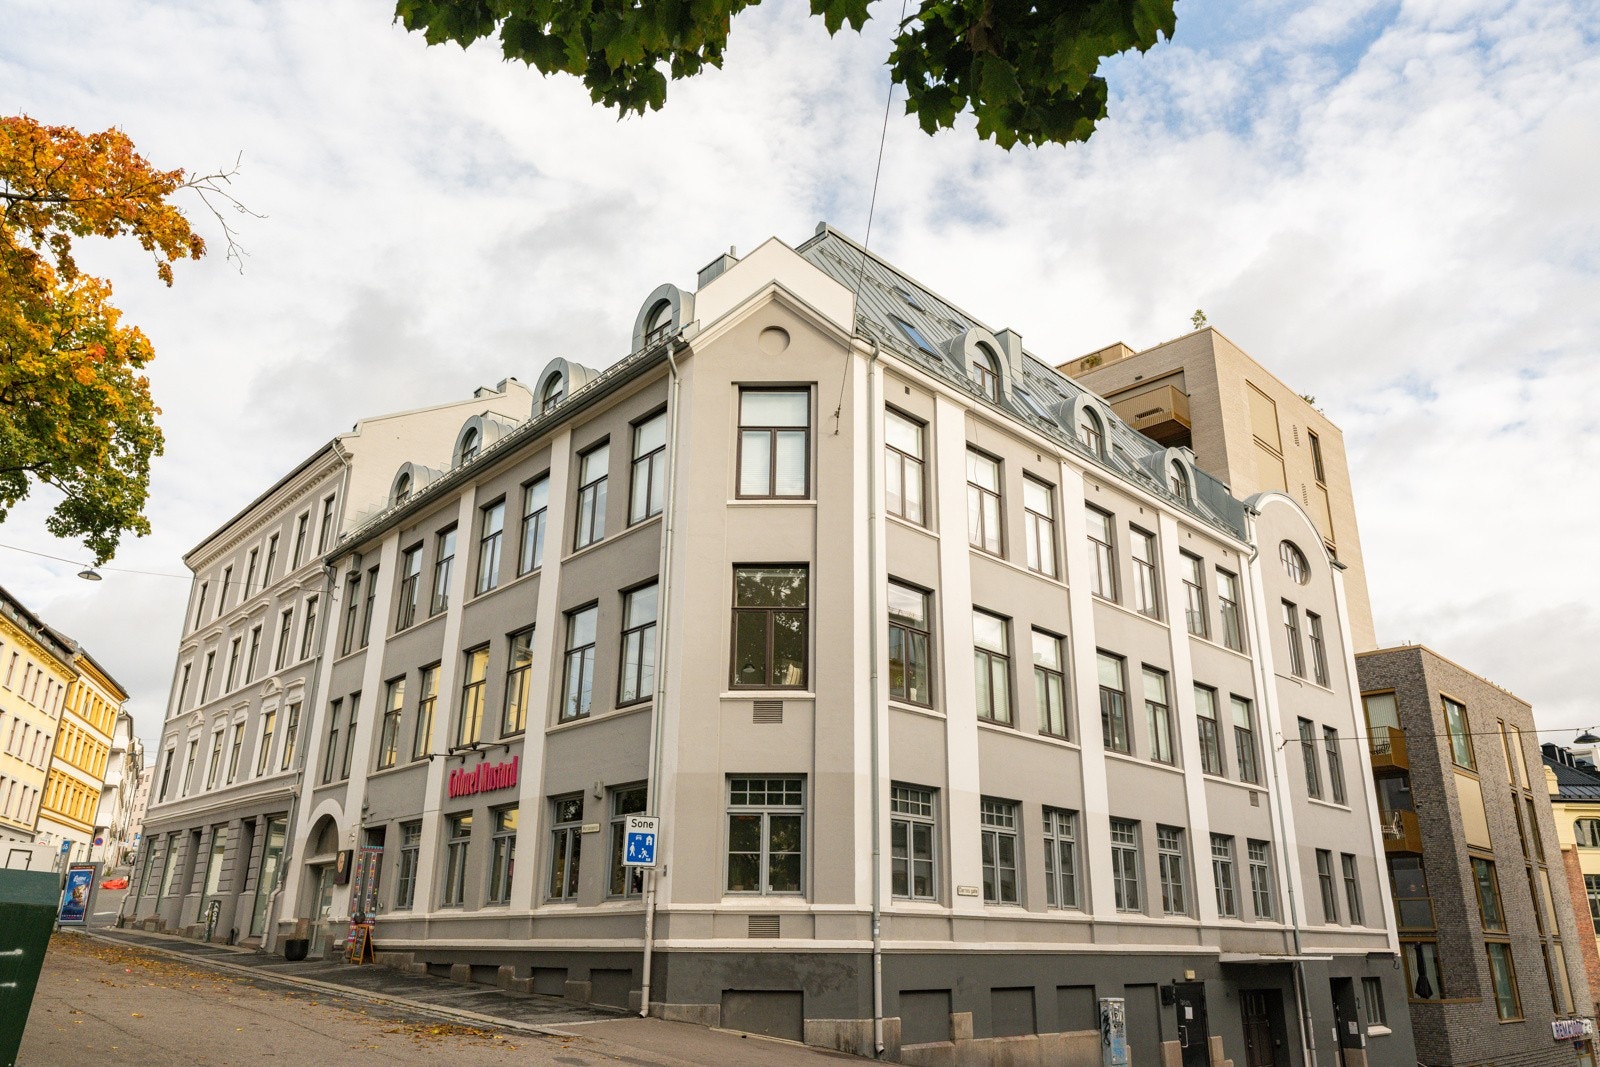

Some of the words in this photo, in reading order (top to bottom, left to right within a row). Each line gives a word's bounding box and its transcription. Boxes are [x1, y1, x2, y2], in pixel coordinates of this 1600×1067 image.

[448, 764, 481, 798] Colonel
[480, 756, 519, 793] Mustard
[631, 818, 654, 829] Sone
